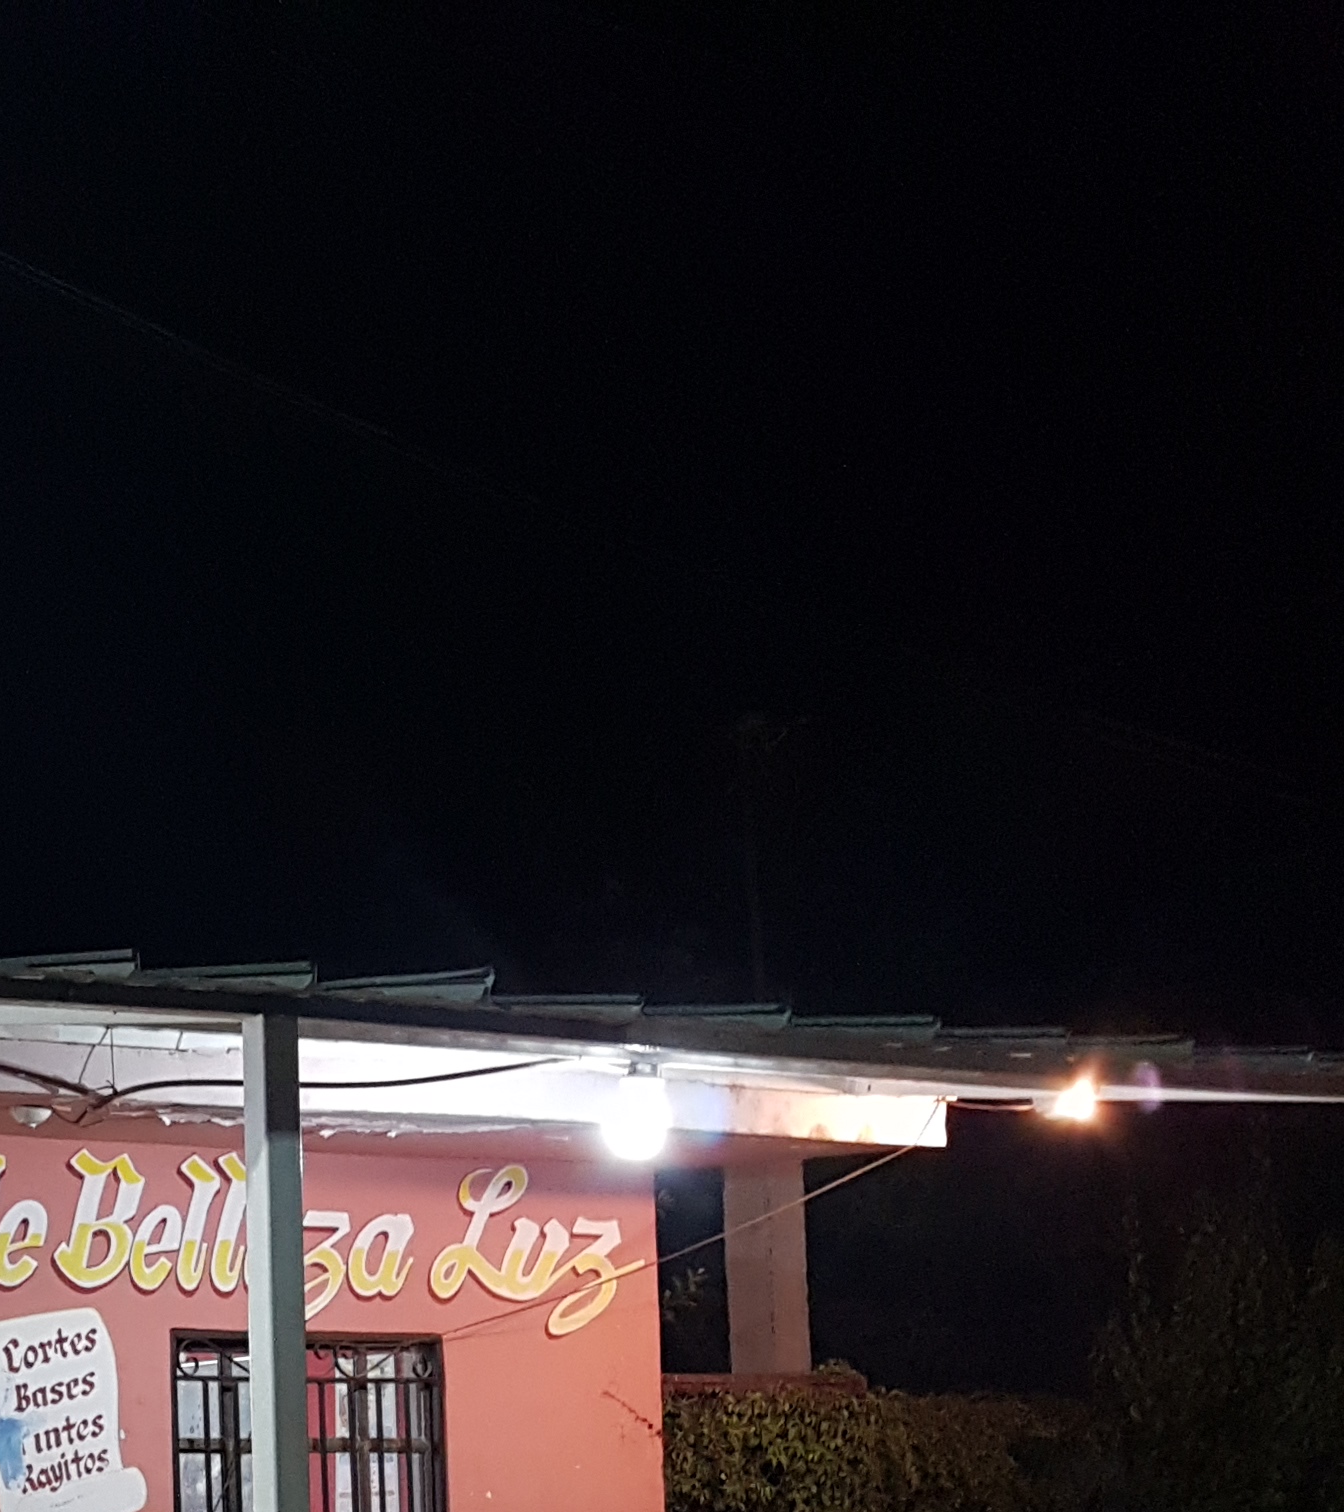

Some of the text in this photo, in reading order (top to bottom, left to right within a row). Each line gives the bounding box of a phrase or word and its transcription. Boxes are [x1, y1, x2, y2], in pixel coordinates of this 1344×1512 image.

[51, 1146, 415, 1321] Bellza
[430, 1164, 646, 1338] Luz
[2, 1327, 98, 1374] Cortes
[14, 1371, 96, 1413] Bases
[21, 1414, 105, 1456] intes
[22, 1449, 109, 1494] Rayitos
